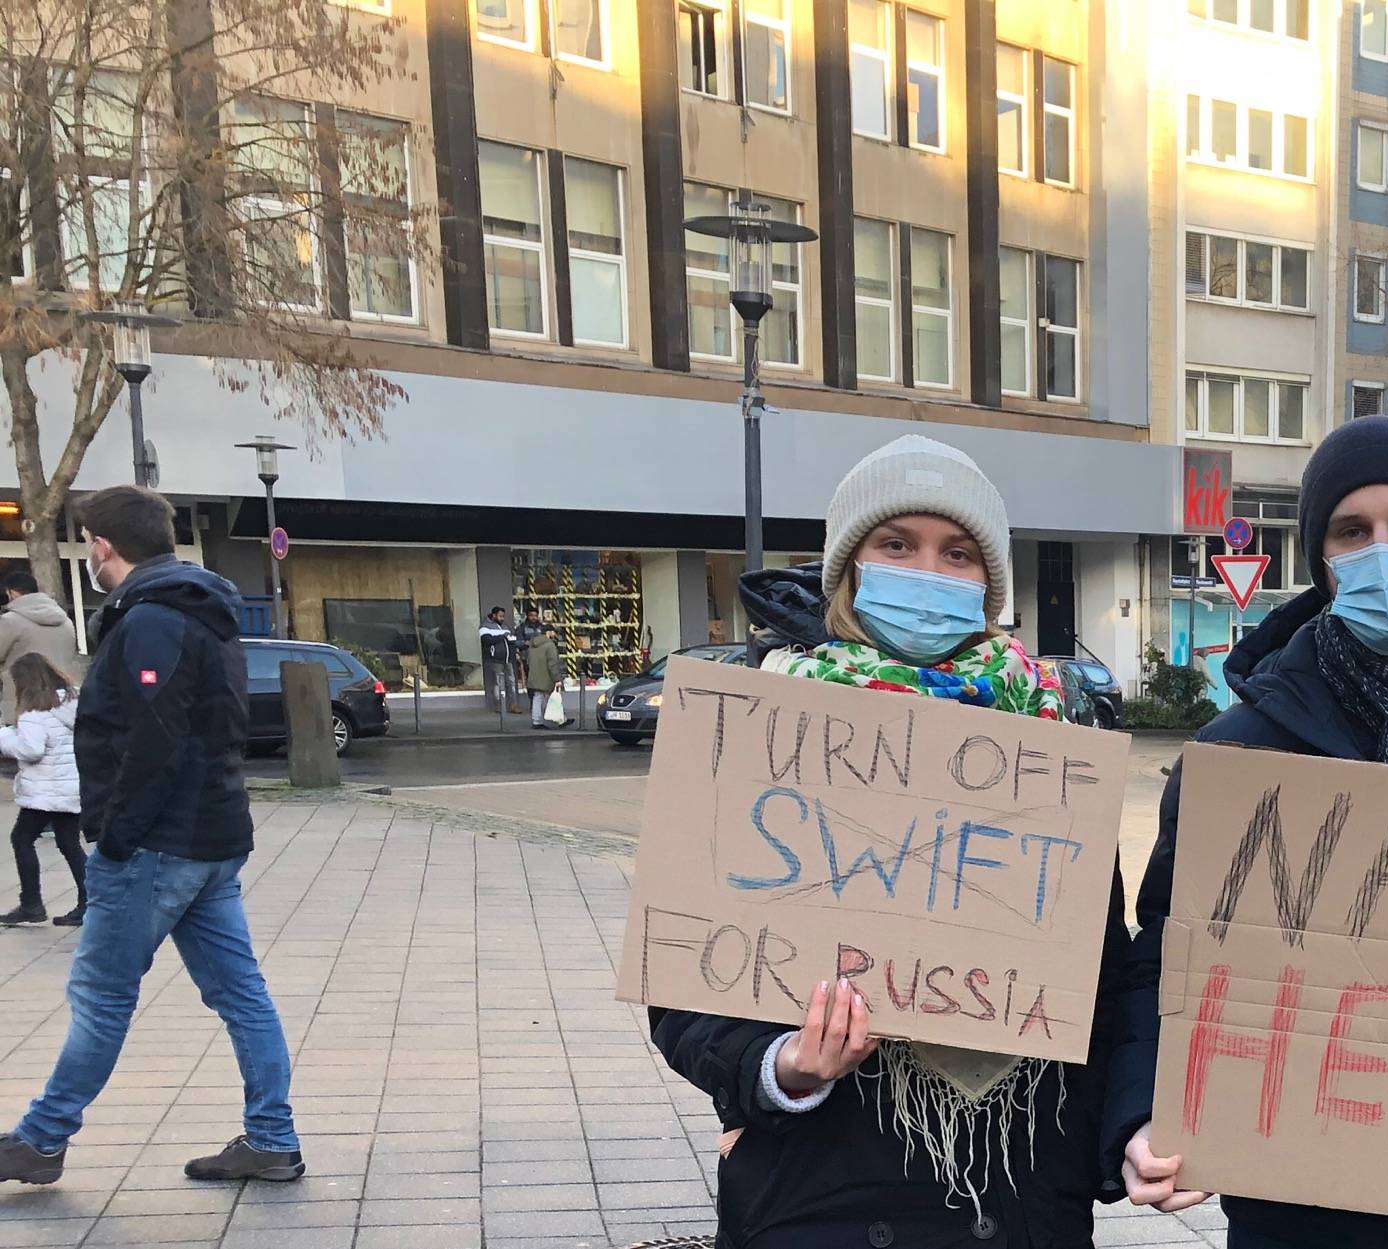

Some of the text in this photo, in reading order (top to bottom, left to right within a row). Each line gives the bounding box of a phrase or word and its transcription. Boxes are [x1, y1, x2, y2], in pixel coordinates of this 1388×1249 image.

[679, 687, 1101, 806] TURN OFF
[641, 904, 809, 1012] FOR
